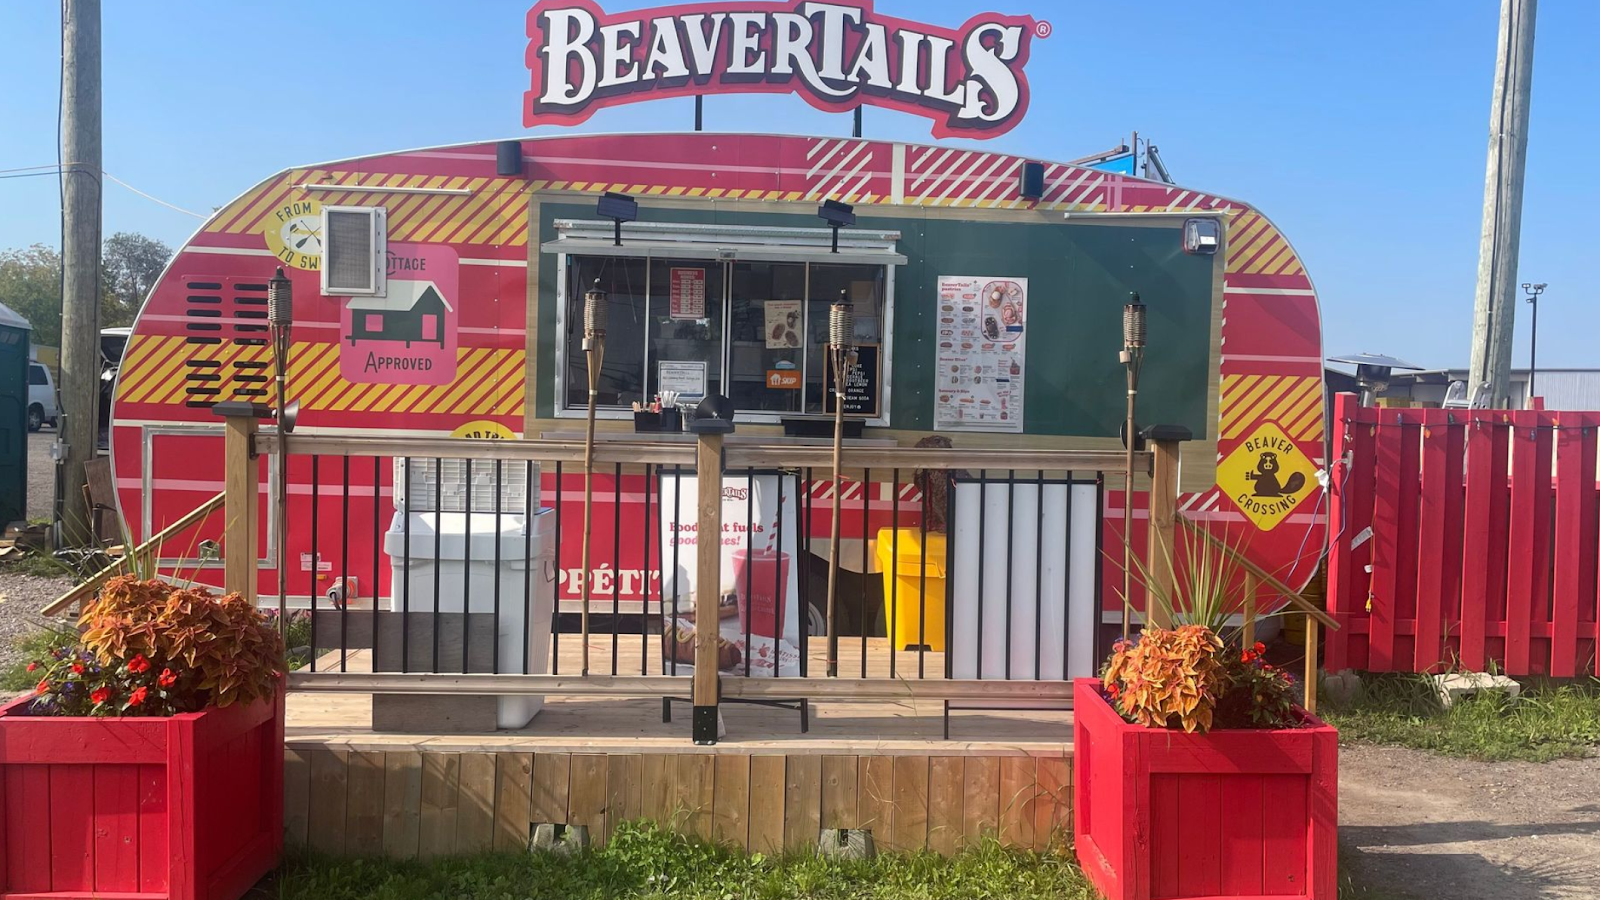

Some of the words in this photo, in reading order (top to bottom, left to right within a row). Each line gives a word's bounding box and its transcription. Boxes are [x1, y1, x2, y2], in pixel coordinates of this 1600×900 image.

[540, 3, 1025, 121] BEAVERTAILS
[276, 202, 312, 222] FROM
[278, 246, 295, 263] TO
[364, 351, 432, 373] APPROVED
[1245, 436, 1293, 455] BEAVER
[1237, 493, 1297, 515] CROSSING
[733, 522, 764, 533] fuls
